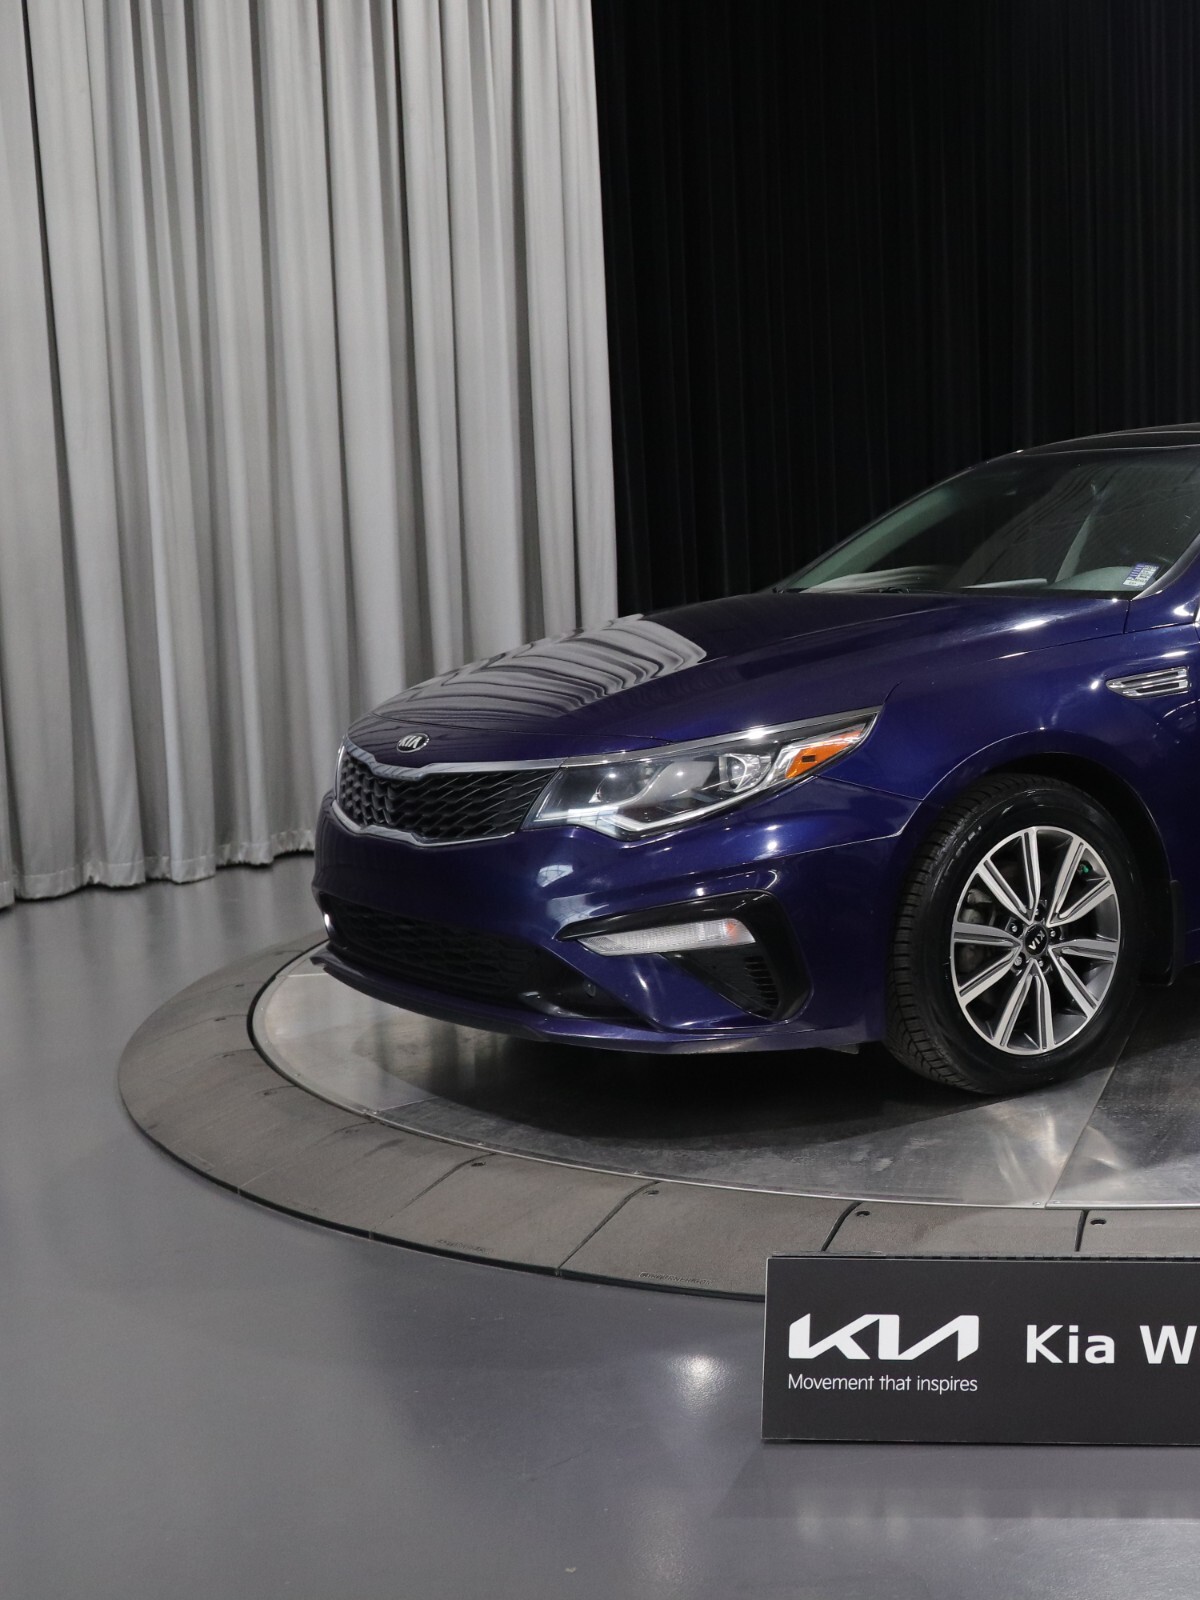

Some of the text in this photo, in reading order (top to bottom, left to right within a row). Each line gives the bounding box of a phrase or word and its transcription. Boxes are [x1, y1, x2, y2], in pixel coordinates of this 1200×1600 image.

[398, 735, 423, 749] KIA
[1028, 930, 1045, 950] KIA
[789, 1313, 980, 1362] KIA
[1025, 1324, 1115, 1365] Kia
[788, 1373, 978, 1396] Movement that inspires
